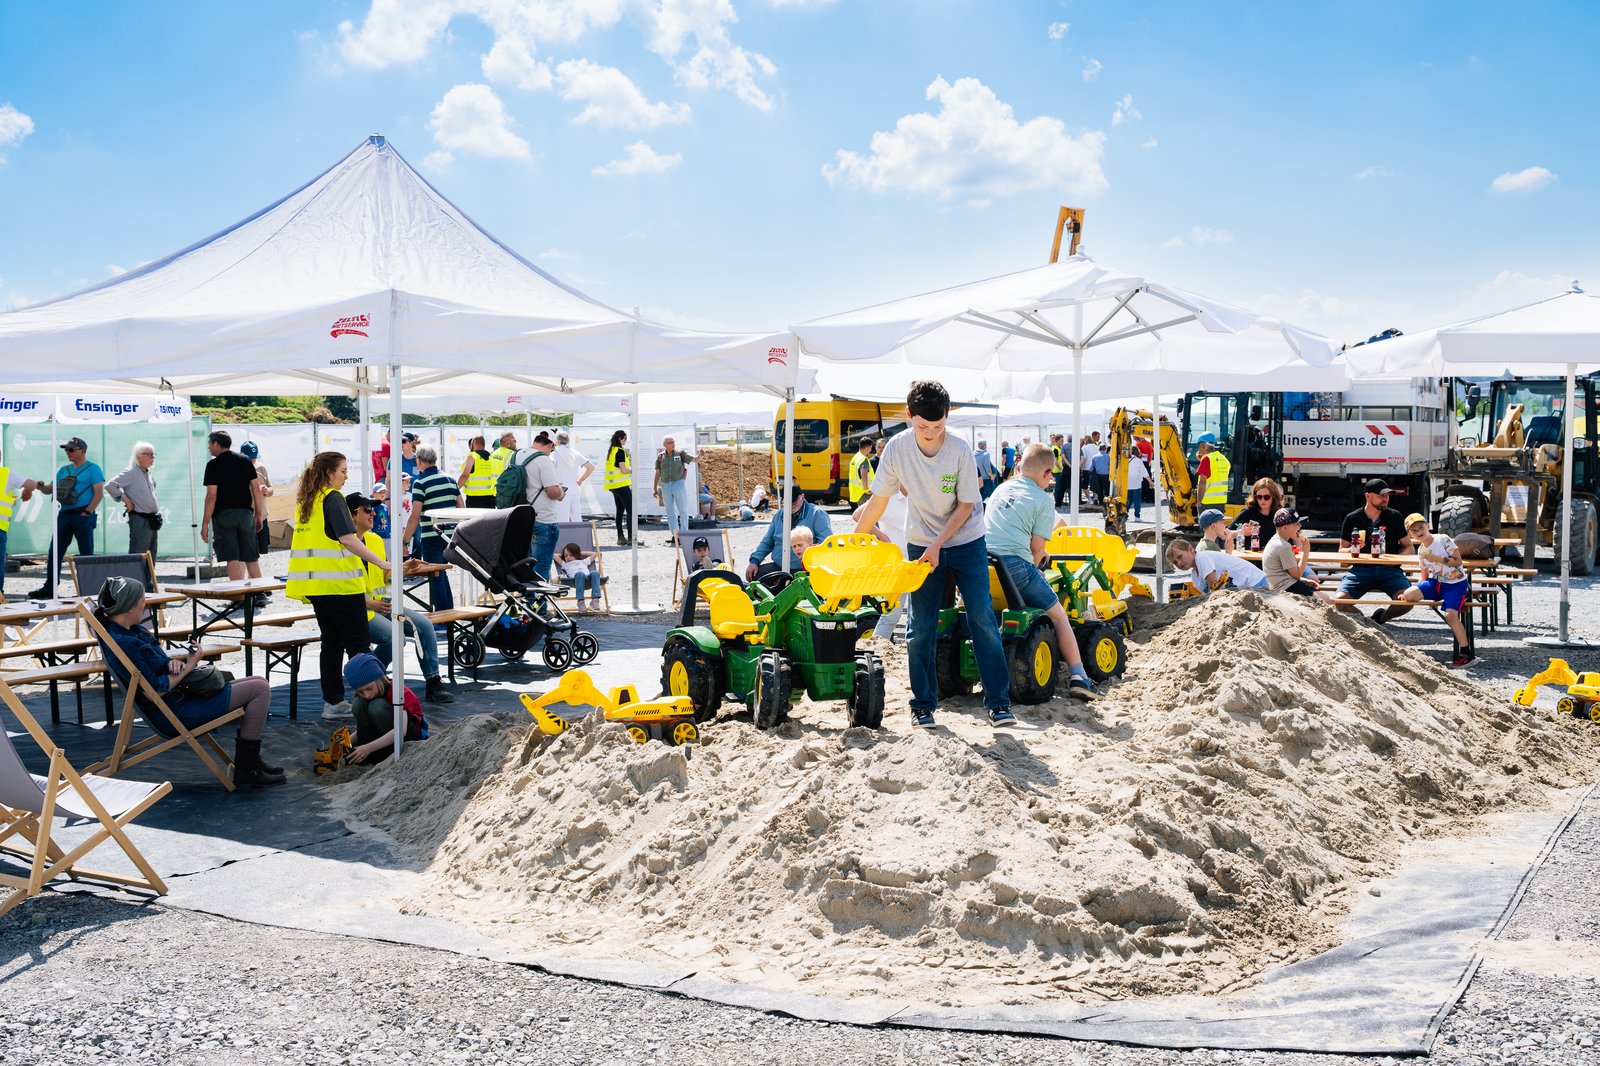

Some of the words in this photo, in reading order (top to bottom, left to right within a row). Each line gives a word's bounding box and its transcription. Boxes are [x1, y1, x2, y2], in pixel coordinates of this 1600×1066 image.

[330, 357, 363, 365] MASTERTENT
[75, 399, 139, 415] Ensinger
[159, 404, 182, 416] nsinger
[1283, 434, 1387, 448] linesystems.de
